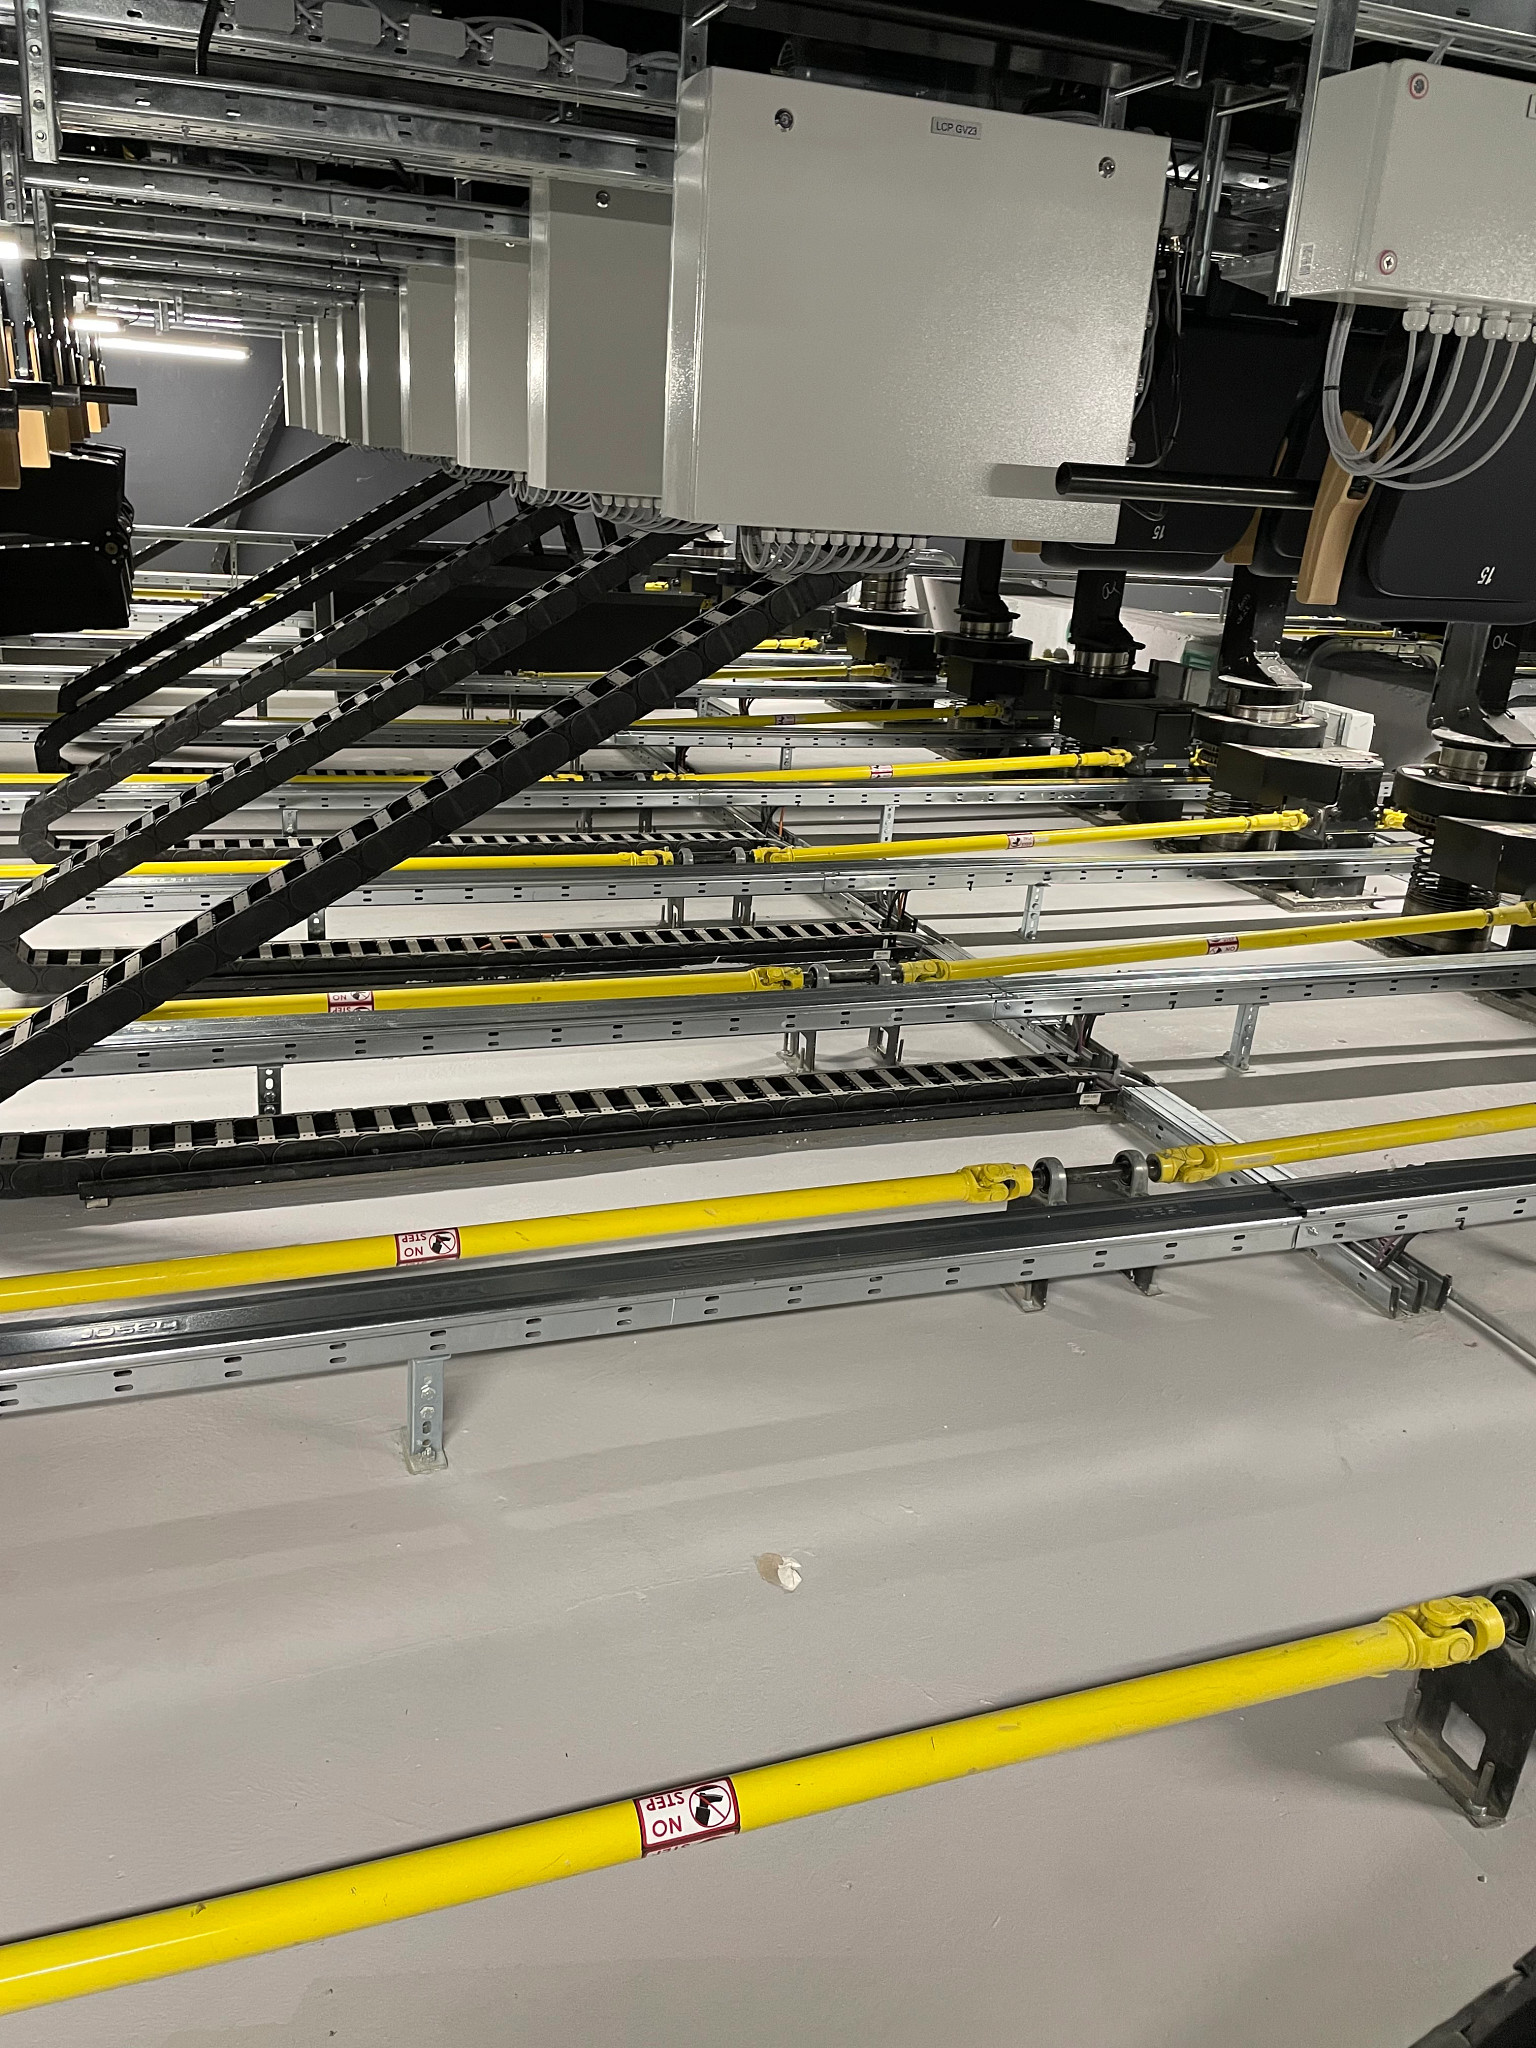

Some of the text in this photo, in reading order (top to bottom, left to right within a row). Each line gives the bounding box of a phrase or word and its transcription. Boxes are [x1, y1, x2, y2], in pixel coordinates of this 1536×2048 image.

[936, 121, 977, 136] LCP GV23
[1151, 525, 1166, 540] 15
[1477, 566, 1496, 585] 15
[1492, 632, 1517, 650] OK
[401, 1233, 427, 1243] STEP
[404, 1245, 424, 1258] NO
[646, 1791, 685, 1812] STEP
[652, 1815, 683, 1838] NO
